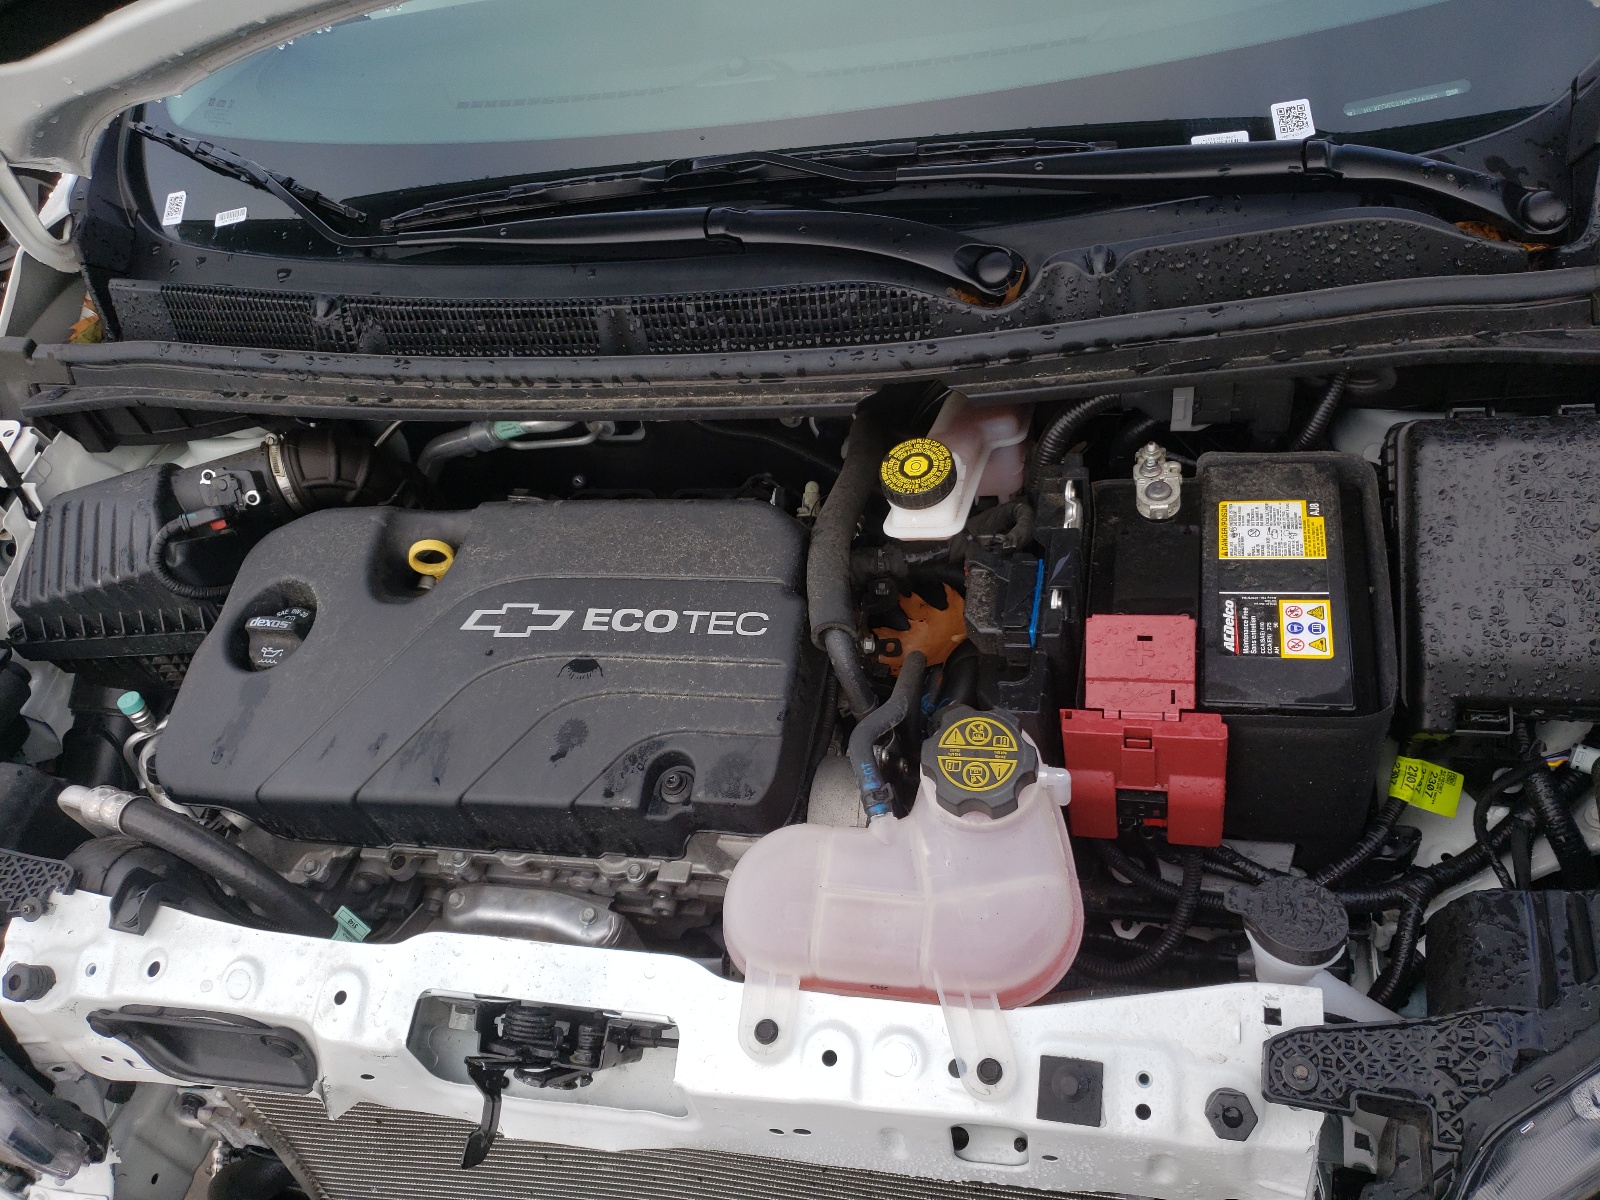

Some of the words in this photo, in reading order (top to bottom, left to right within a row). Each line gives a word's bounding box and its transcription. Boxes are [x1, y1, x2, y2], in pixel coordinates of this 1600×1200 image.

[250, 616, 292, 628] dexos
[582, 608, 770, 636] ECOTEC
[1222, 600, 1235, 652] ACDelco
[1405, 765, 1418, 791] 2307
[1425, 772, 1438, 798] 2307
